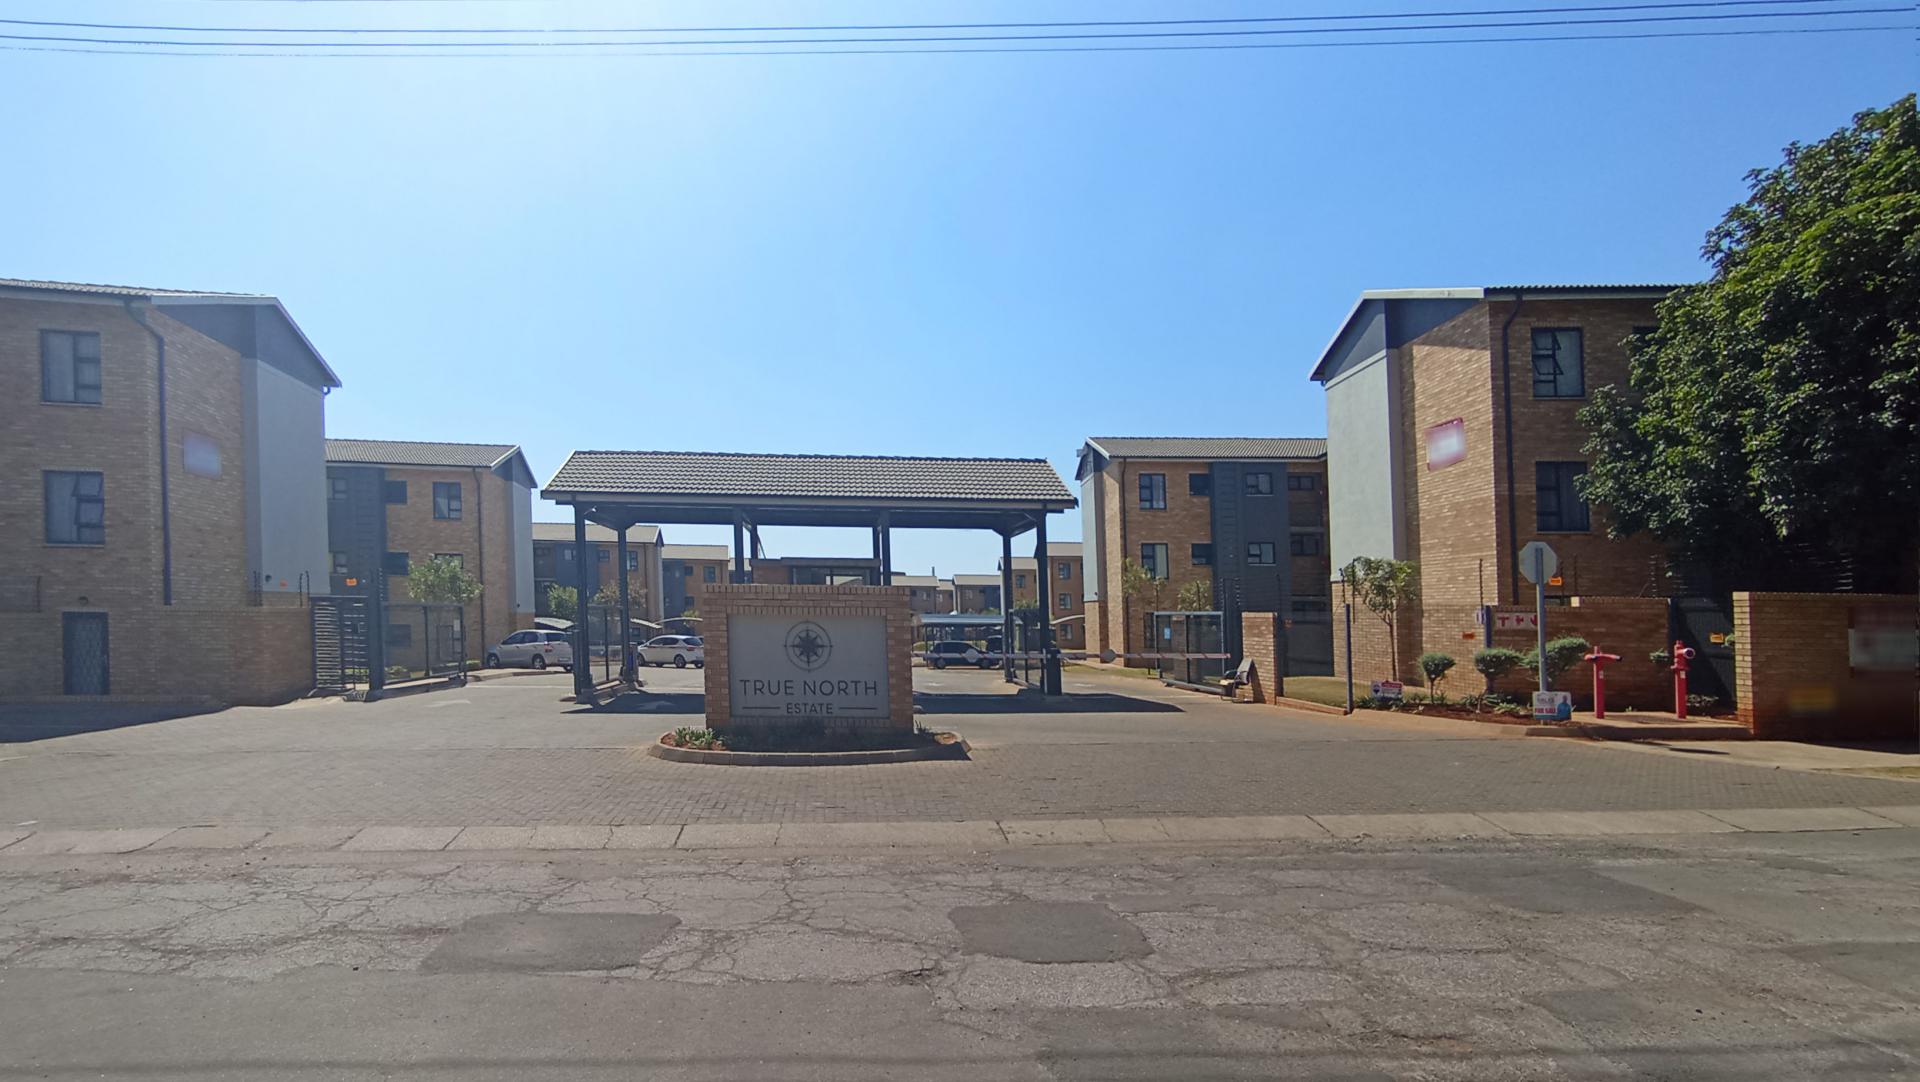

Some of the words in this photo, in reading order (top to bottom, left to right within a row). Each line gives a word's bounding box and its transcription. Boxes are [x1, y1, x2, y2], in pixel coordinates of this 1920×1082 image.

[739, 679, 795, 696] TRUE
[803, 680, 877, 697] NORTH
[786, 702, 834, 715] ESTATE
